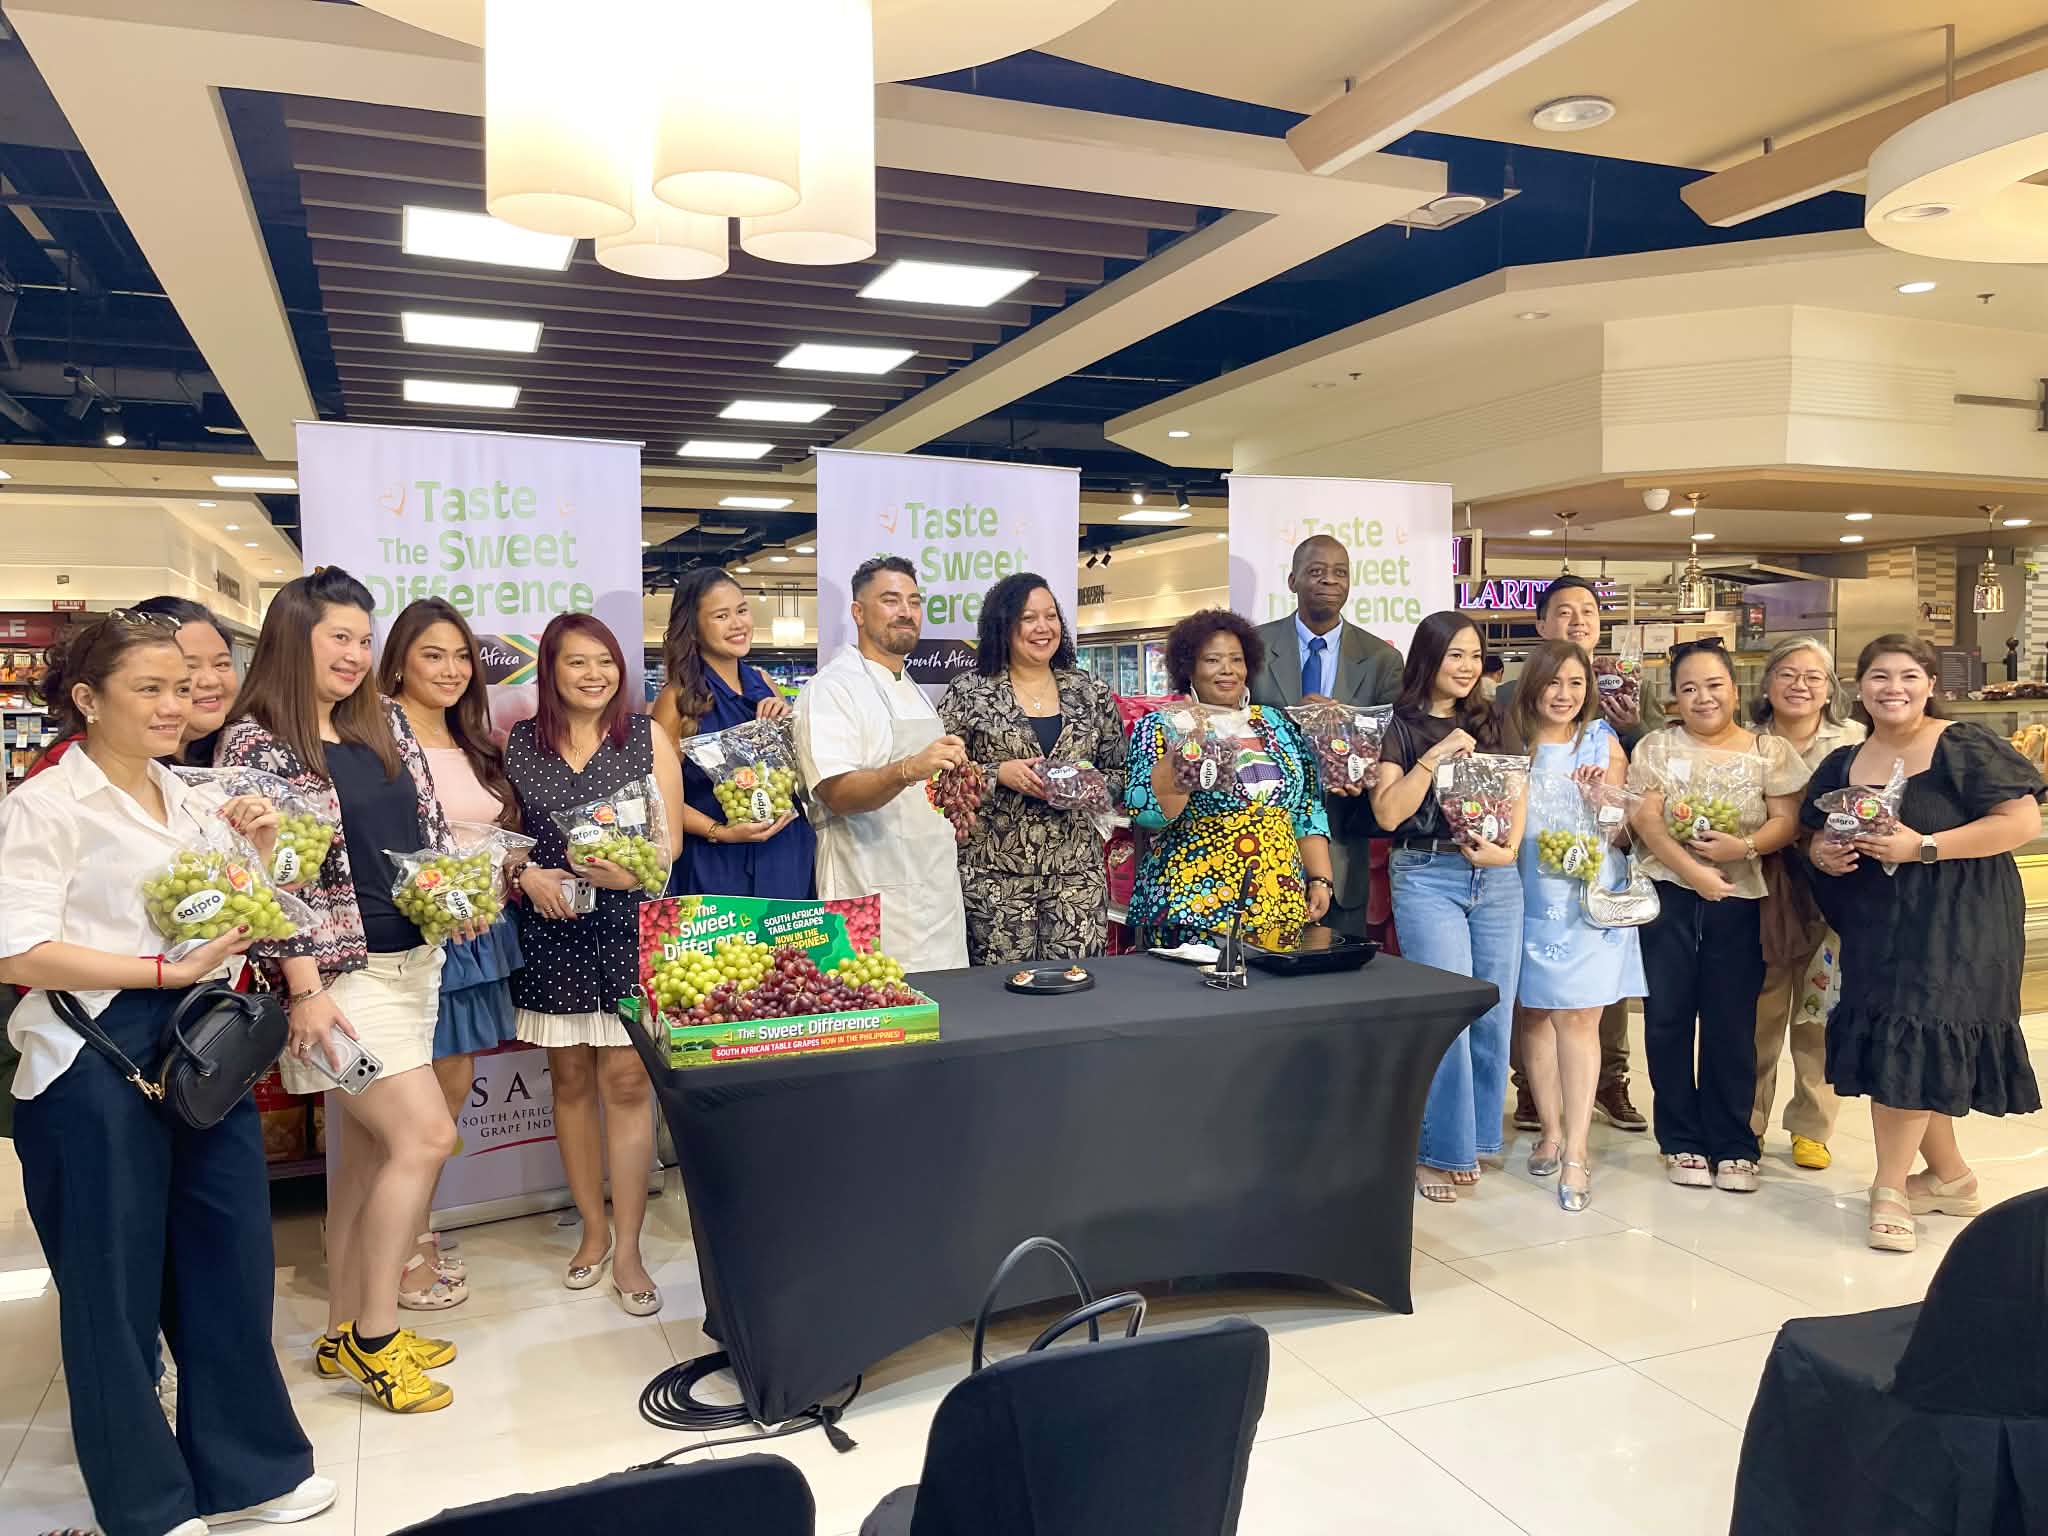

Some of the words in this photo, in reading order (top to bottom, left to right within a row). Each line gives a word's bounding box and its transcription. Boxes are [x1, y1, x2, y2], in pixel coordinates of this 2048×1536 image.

[414, 480, 537, 522] Taste
[904, 502, 998, 540] Taste
[377, 537, 428, 565] The
[439, 529, 578, 572] Sweet
[920, 546, 1029, 583] Sweet
[1460, 579, 1553, 610] LART
[1267, 592, 1421, 625] Dience
[479, 646, 520, 667] Africa
[904, 651, 942, 670] South
[944, 649, 978, 670] Afric
[1205, 762, 1214, 787] safpro
[177, 893, 221, 919] safpro
[696, 904, 717, 918] The
[763, 913, 791, 928] SOUTH
[791, 906, 825, 921] AFRICAN
[680, 911, 737, 938] Sweet
[768, 922, 792, 935] TABLE
[792, 916, 824, 929] GRAPES
[775, 933, 794, 945] NOW
[795, 931, 803, 941] IN
[804, 927, 819, 938] THE
[664, 930, 757, 960] Differene
[738, 1028, 755, 1040] The
[759, 1022, 804, 1040] Sweet
[808, 1015, 881, 1035] Difference
[716, 1048, 740, 1057] SOUTH
[741, 1045, 770, 1056] AFRICAN
[771, 1042, 792, 1052] TABLE
[793, 1039, 820, 1049] GRAPES
[821, 1037, 837, 1046] NOW
[845, 1034, 859, 1043] THE
[462, 1113, 507, 1128] SOUTH
[512, 1106, 553, 1121] AFRIC
[480, 1124, 521, 1138] GRAPE
[527, 1119, 552, 1131] IND
